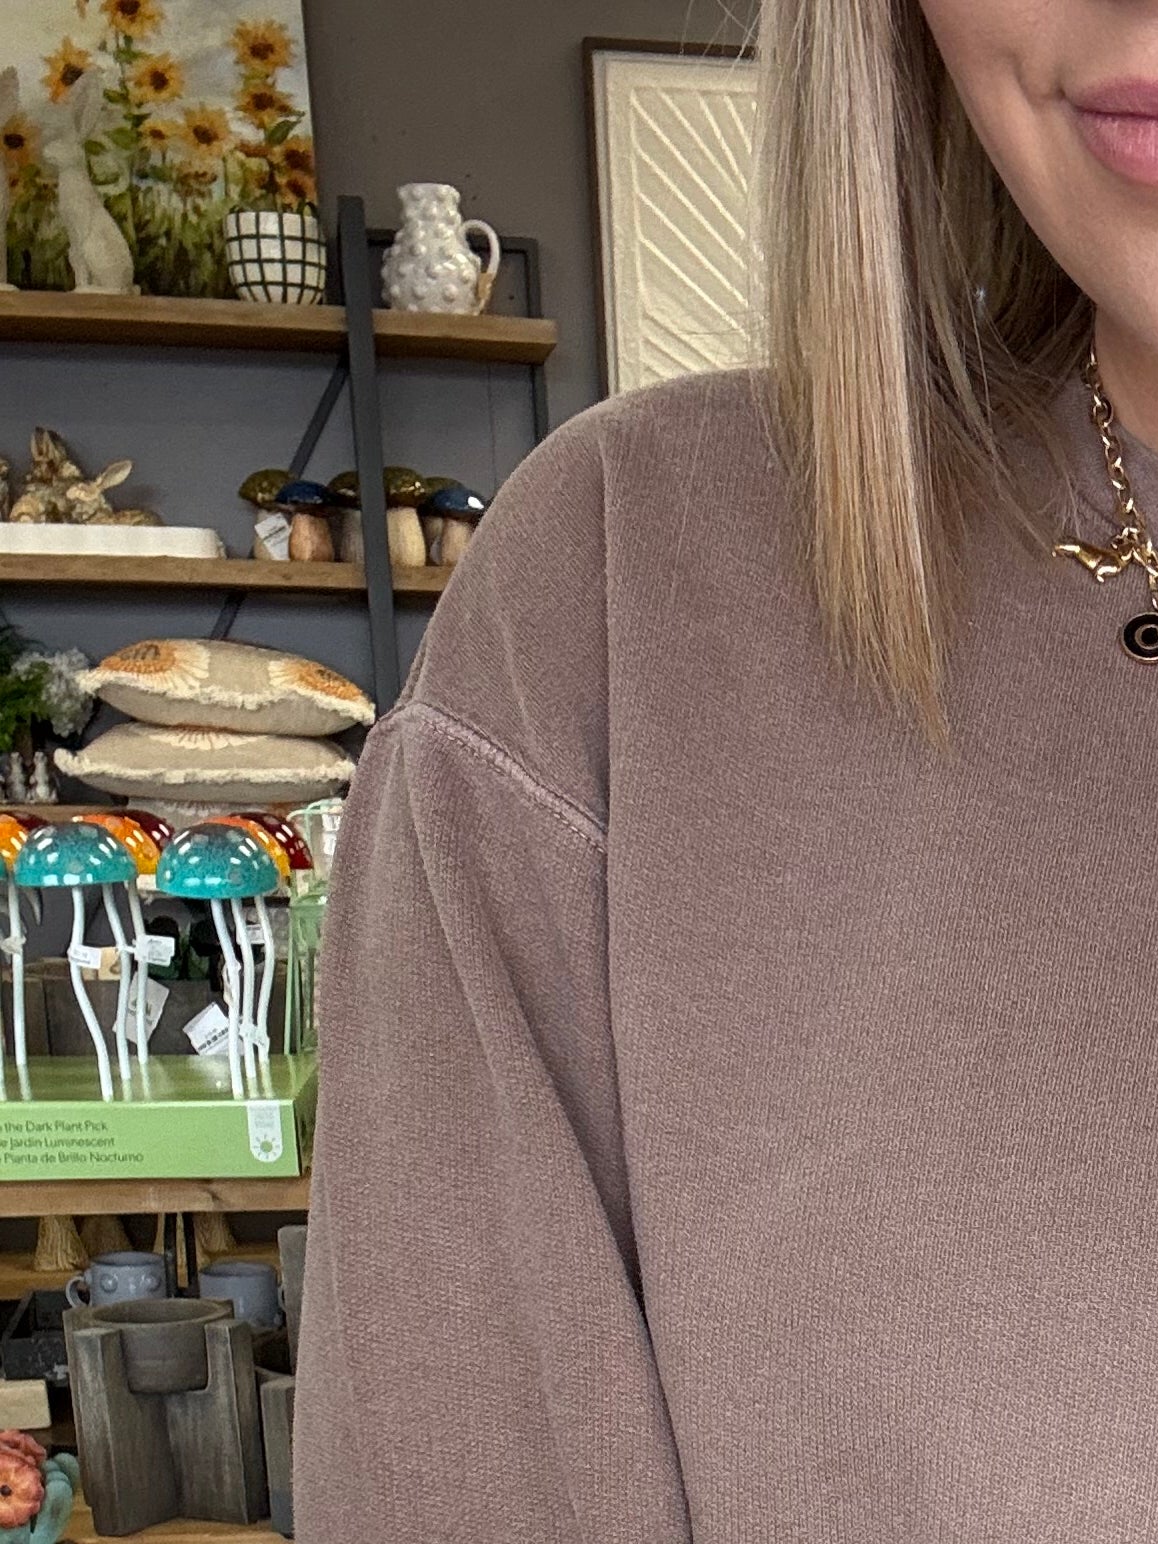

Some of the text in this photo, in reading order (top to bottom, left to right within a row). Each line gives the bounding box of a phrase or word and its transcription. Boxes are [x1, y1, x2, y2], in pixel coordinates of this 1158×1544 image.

[25, 1120, 53, 1132] Dark
[55, 1120, 82, 1132] Plant
[84, 1120, 108, 1131] Pick
[4, 1152, 38, 1163] Planta
[41, 1152, 56, 1162] de
[58, 1151, 87, 1163] Brillo
